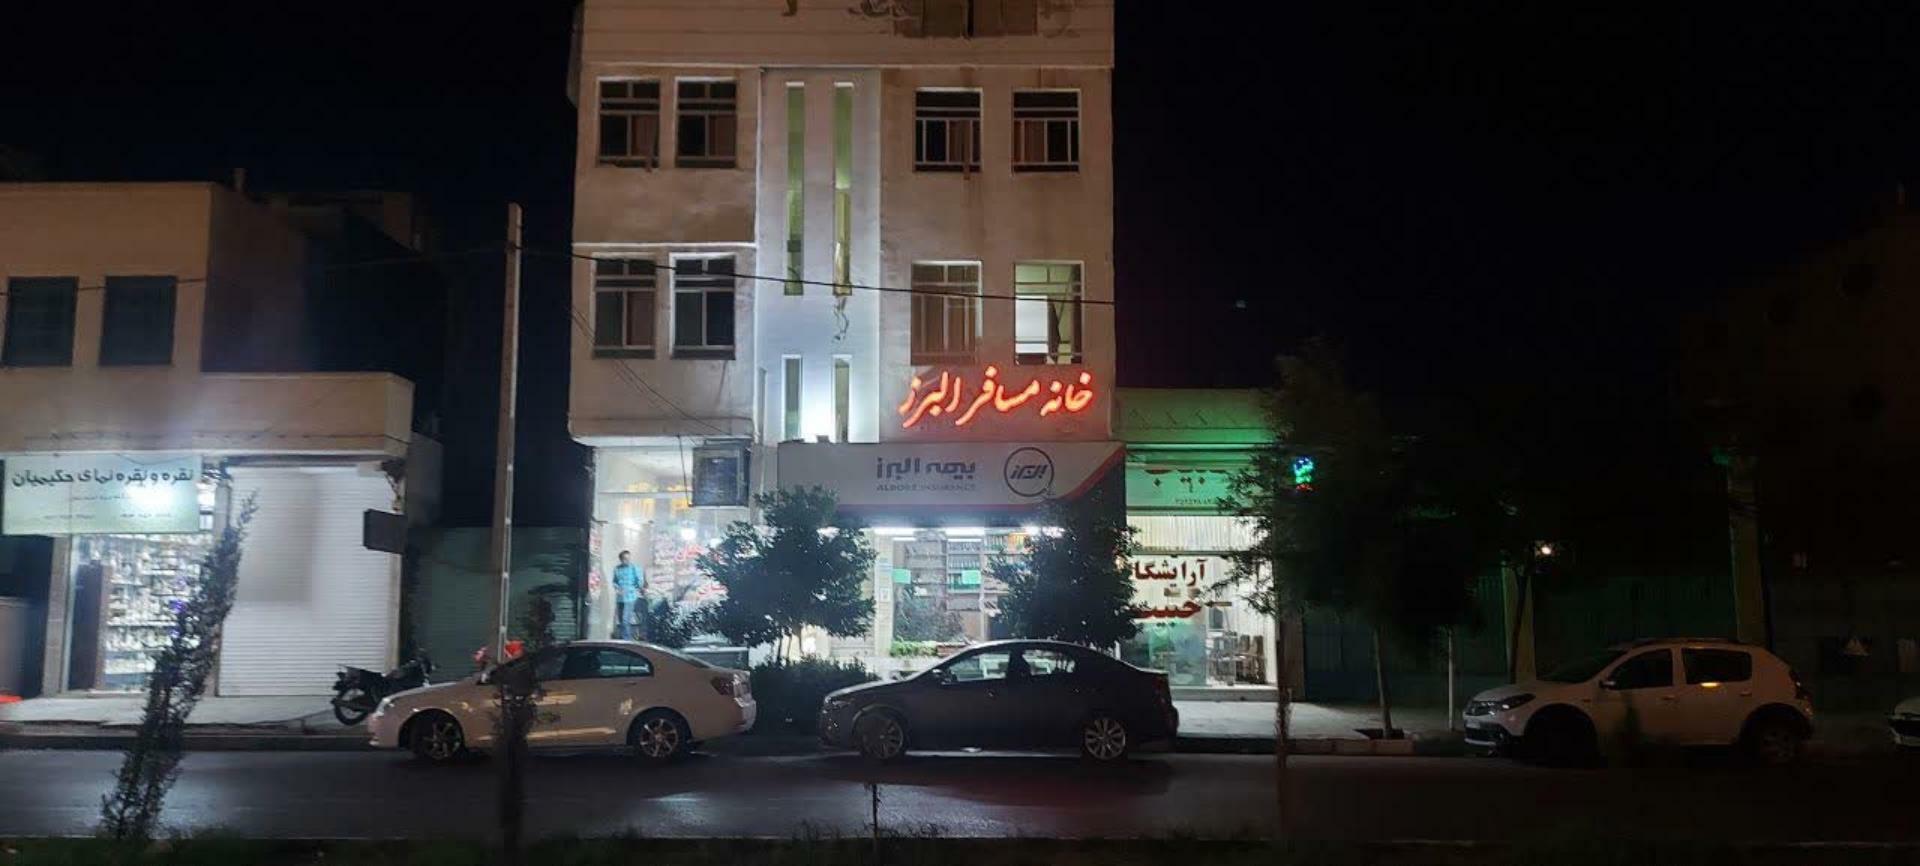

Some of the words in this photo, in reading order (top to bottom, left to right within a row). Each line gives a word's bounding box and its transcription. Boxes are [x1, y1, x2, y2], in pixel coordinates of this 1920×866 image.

[898, 371, 962, 429] البرز
[955, 365, 1041, 426] مسافر
[1039, 371, 1093, 416] خانه
[11, 468, 74, 488] حکیمیان
[77, 467, 114, 484] نمای
[116, 468, 147, 487] نقره
[163, 467, 194, 486] نقره
[876, 457, 921, 480] البرز
[926, 459, 976, 480] بیمه
[150, 474, 158, 485] و
[1134, 558, 1208, 587] آرایشگا
